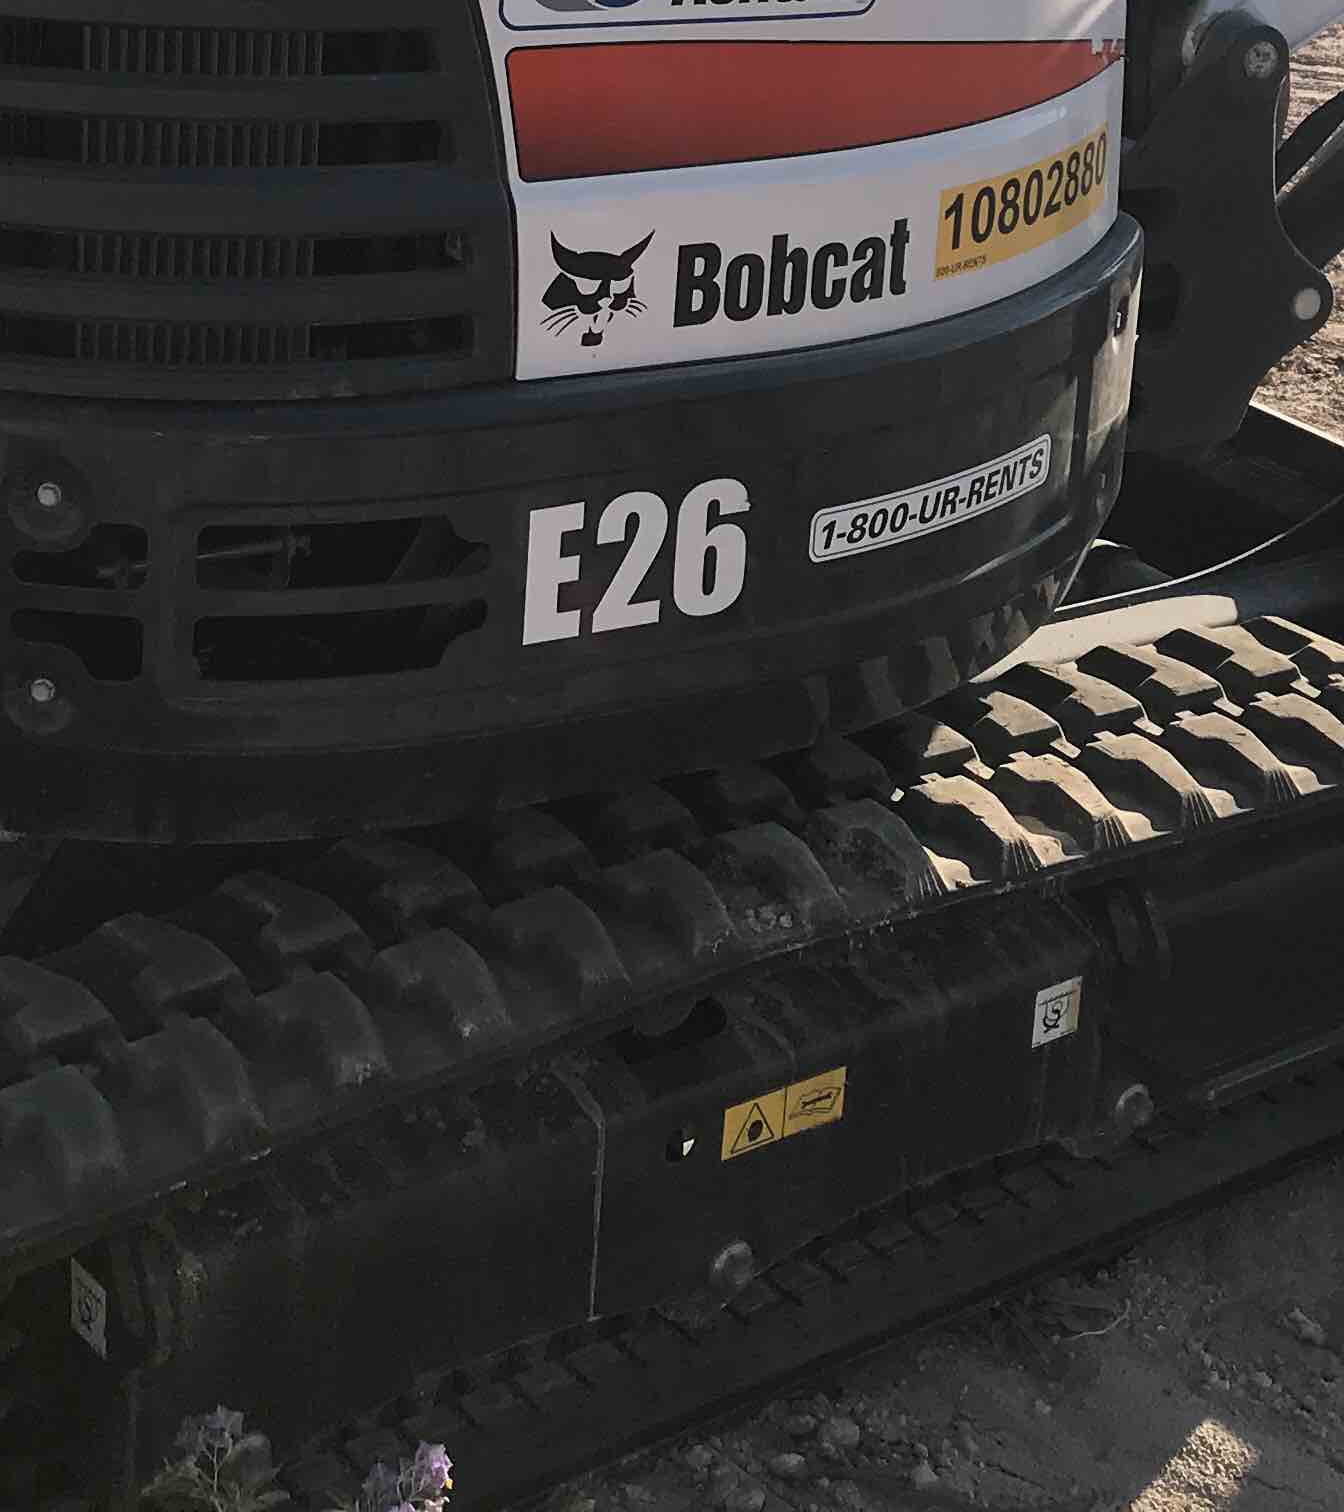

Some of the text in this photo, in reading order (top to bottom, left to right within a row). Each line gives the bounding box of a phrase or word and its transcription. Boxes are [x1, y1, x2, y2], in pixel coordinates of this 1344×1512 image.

[944, 131, 1107, 251] 10802880
[672, 218, 911, 328] Bobcat
[821, 447, 1045, 550] 1-800-UR-RENTS
[521, 477, 752, 646] E26
